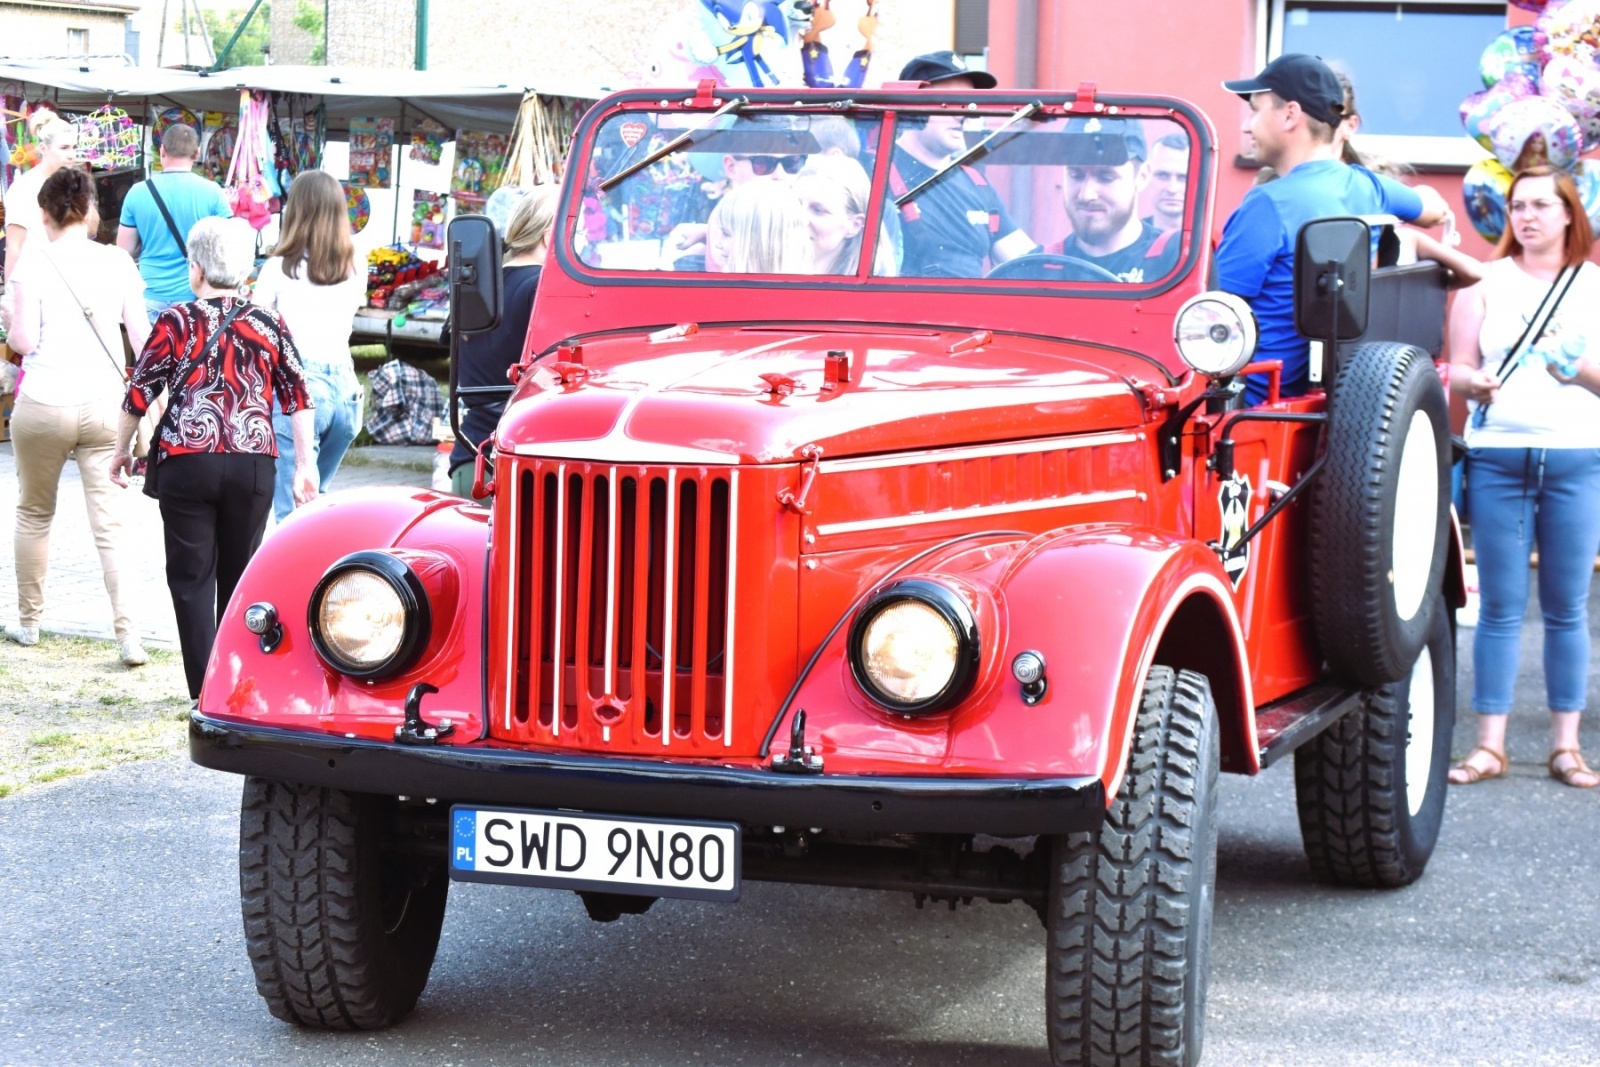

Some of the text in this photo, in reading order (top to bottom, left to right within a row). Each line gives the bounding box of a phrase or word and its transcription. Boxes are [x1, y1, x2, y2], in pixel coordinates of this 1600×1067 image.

[456, 846, 473, 861] PL
[484, 818, 725, 883] SWD 9N80
